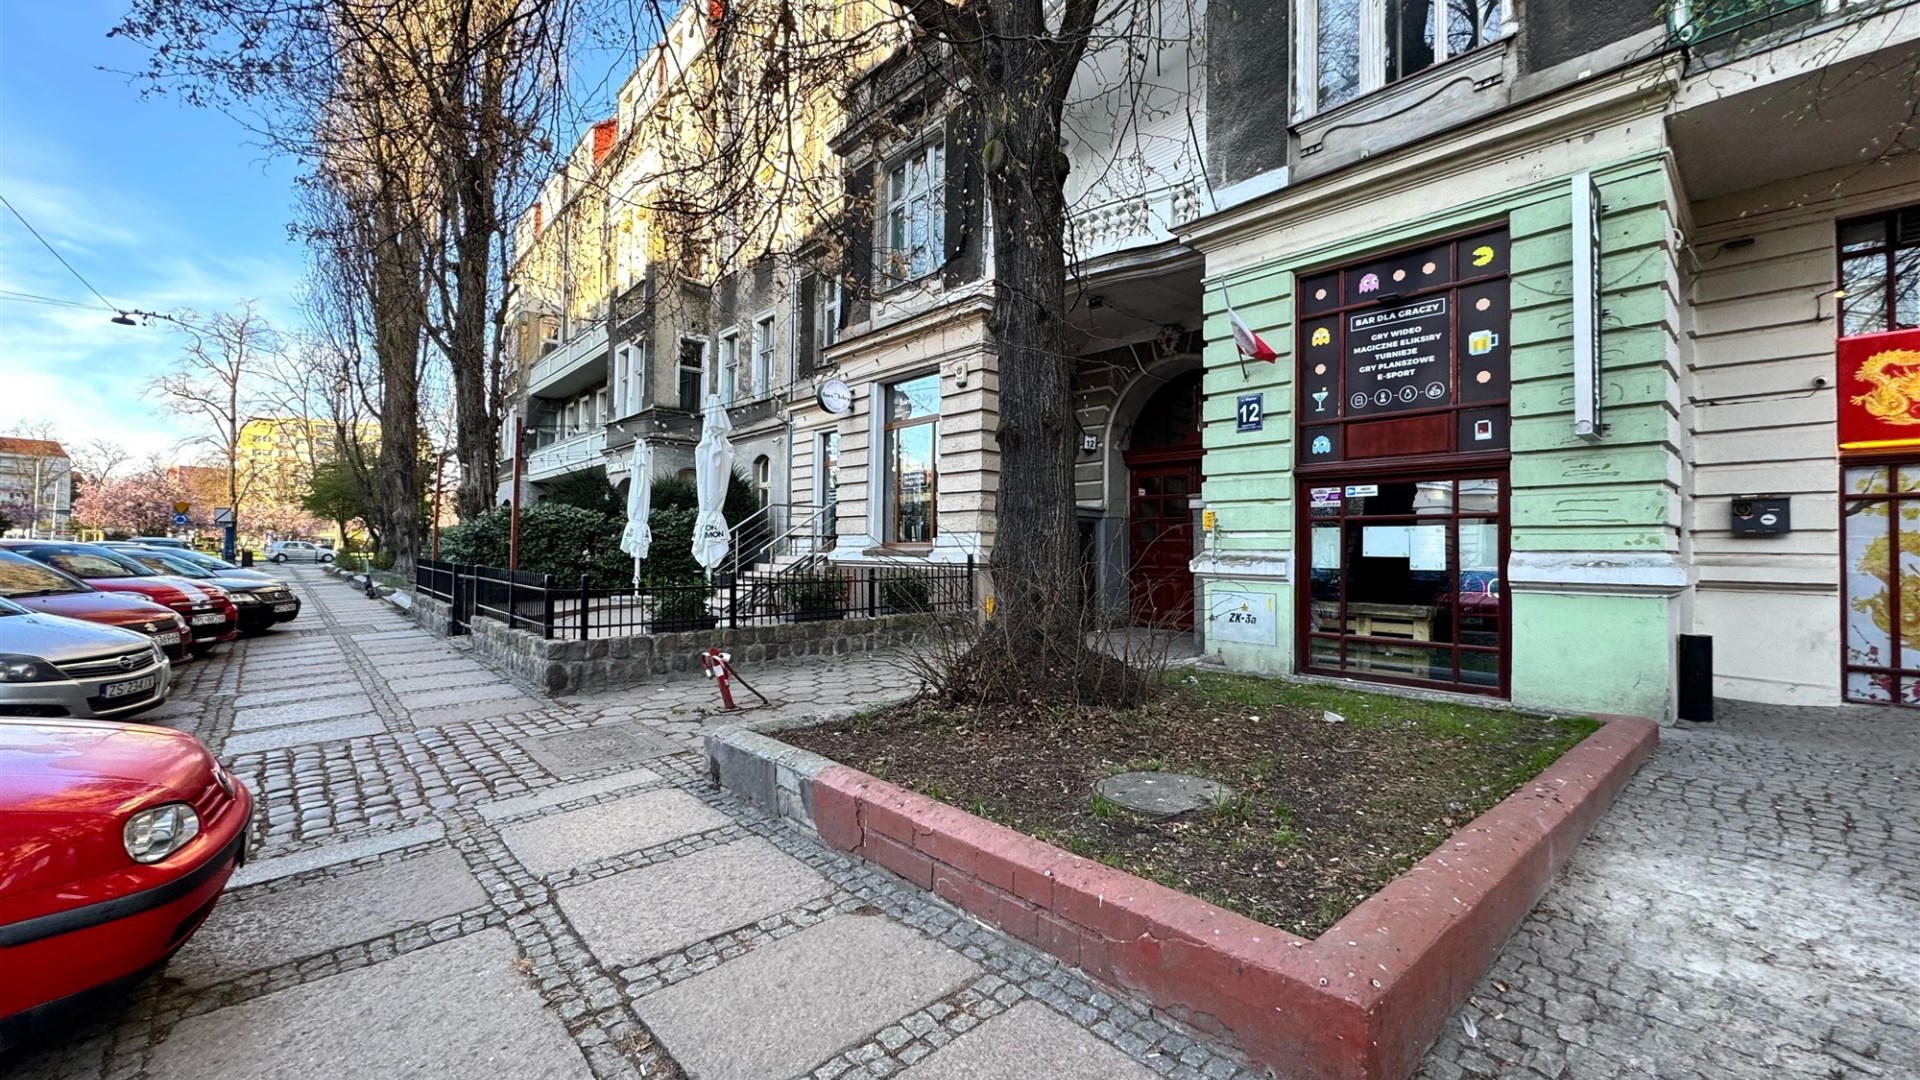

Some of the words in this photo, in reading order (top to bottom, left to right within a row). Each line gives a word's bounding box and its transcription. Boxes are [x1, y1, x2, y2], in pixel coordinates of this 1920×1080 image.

[1355, 316, 1375, 327] BAR
[1376, 312, 1397, 322] DLA
[1398, 303, 1440, 318] GRACZY
[1371, 332, 1389, 341] GRY
[1390, 326, 1422, 338] WIDEO
[1353, 340, 1399, 354] MAGICZNE
[1400, 332, 1442, 346] ELIKSIRY
[1375, 347, 1418, 360] TURNIEJE
[1359, 364, 1377, 373] GRY
[1378, 355, 1435, 370] PLANSZOWE
[1377, 368, 1416, 381] E-SPORT
[1240, 403, 1260, 423] 12
[1229, 612, 1257, 624] ZK-3a
